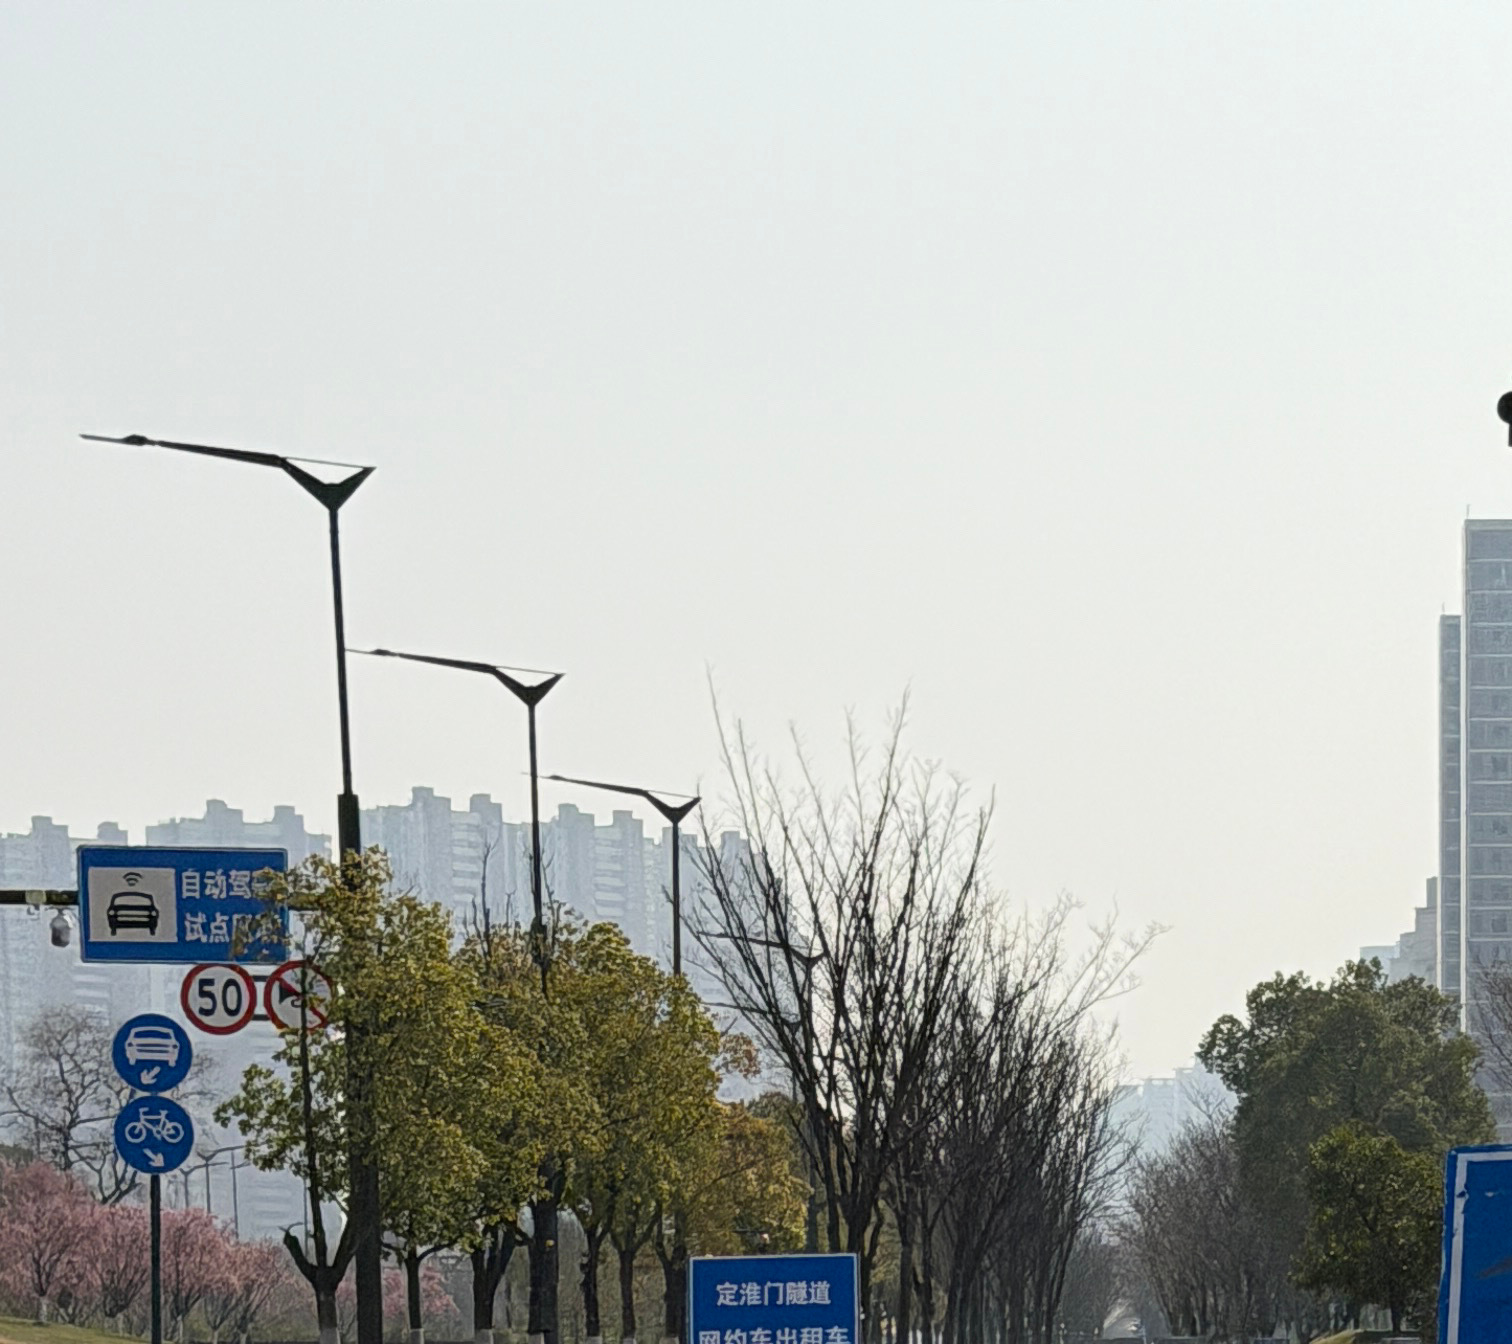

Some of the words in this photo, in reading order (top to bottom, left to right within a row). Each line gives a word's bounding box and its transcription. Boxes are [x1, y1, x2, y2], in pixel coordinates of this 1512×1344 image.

[198, 978, 243, 1016] 50
[716, 1281, 831, 1306] 定淮门隧道
